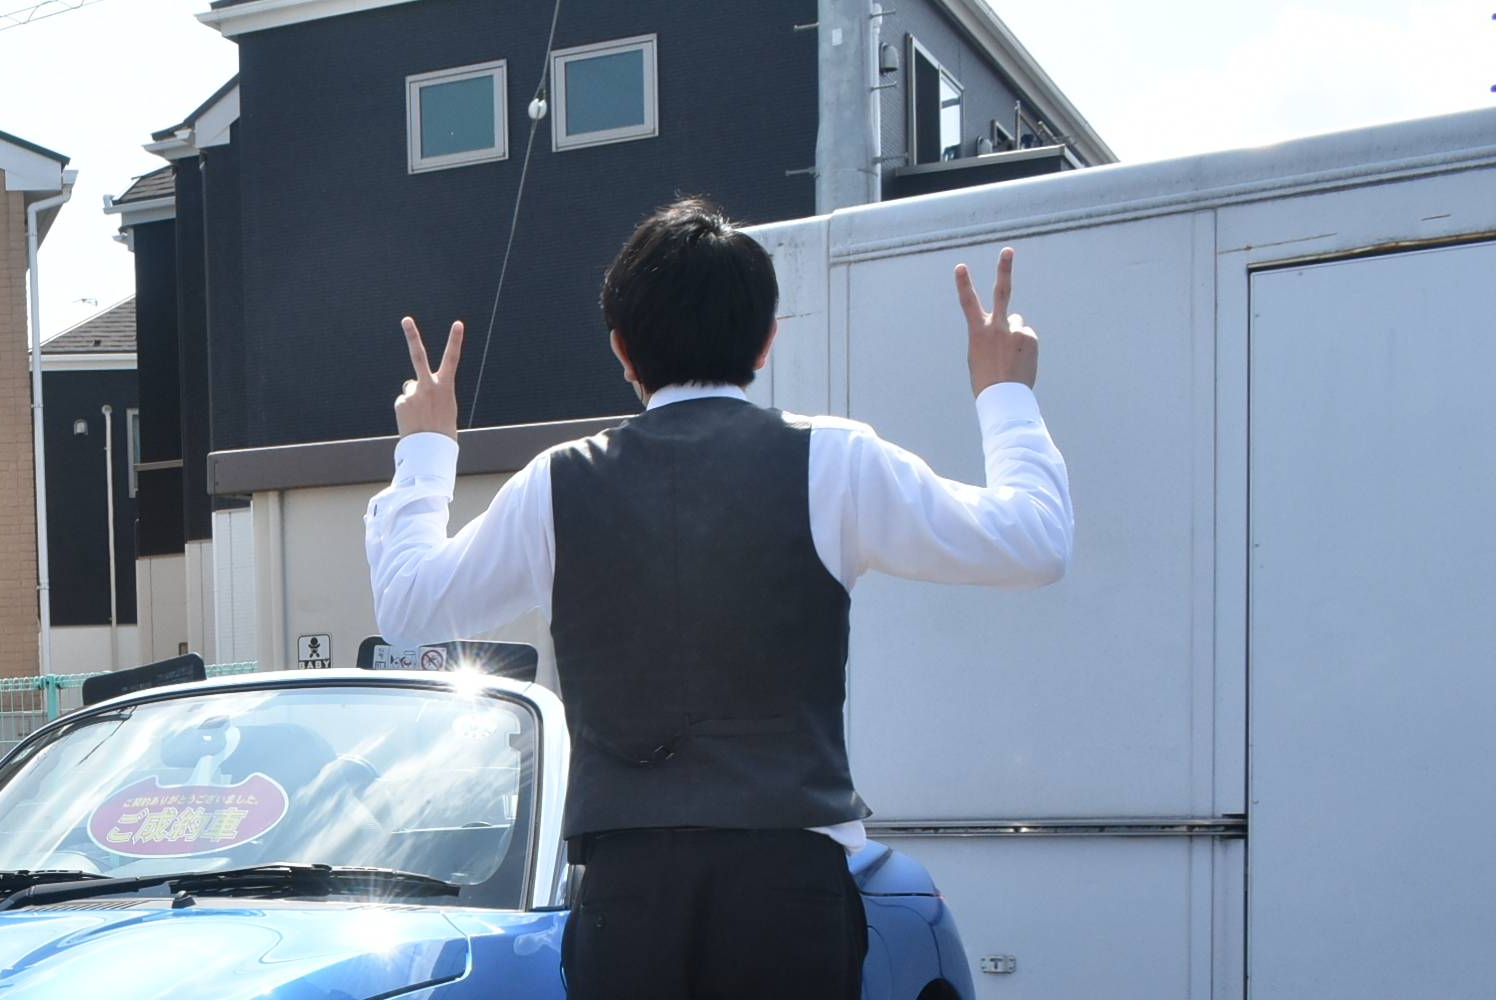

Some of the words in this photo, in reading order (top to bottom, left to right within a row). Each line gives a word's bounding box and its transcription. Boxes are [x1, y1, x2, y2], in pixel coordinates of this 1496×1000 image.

[298, 660, 330, 669] BABY
[106, 807, 248, 844] ご成約車
